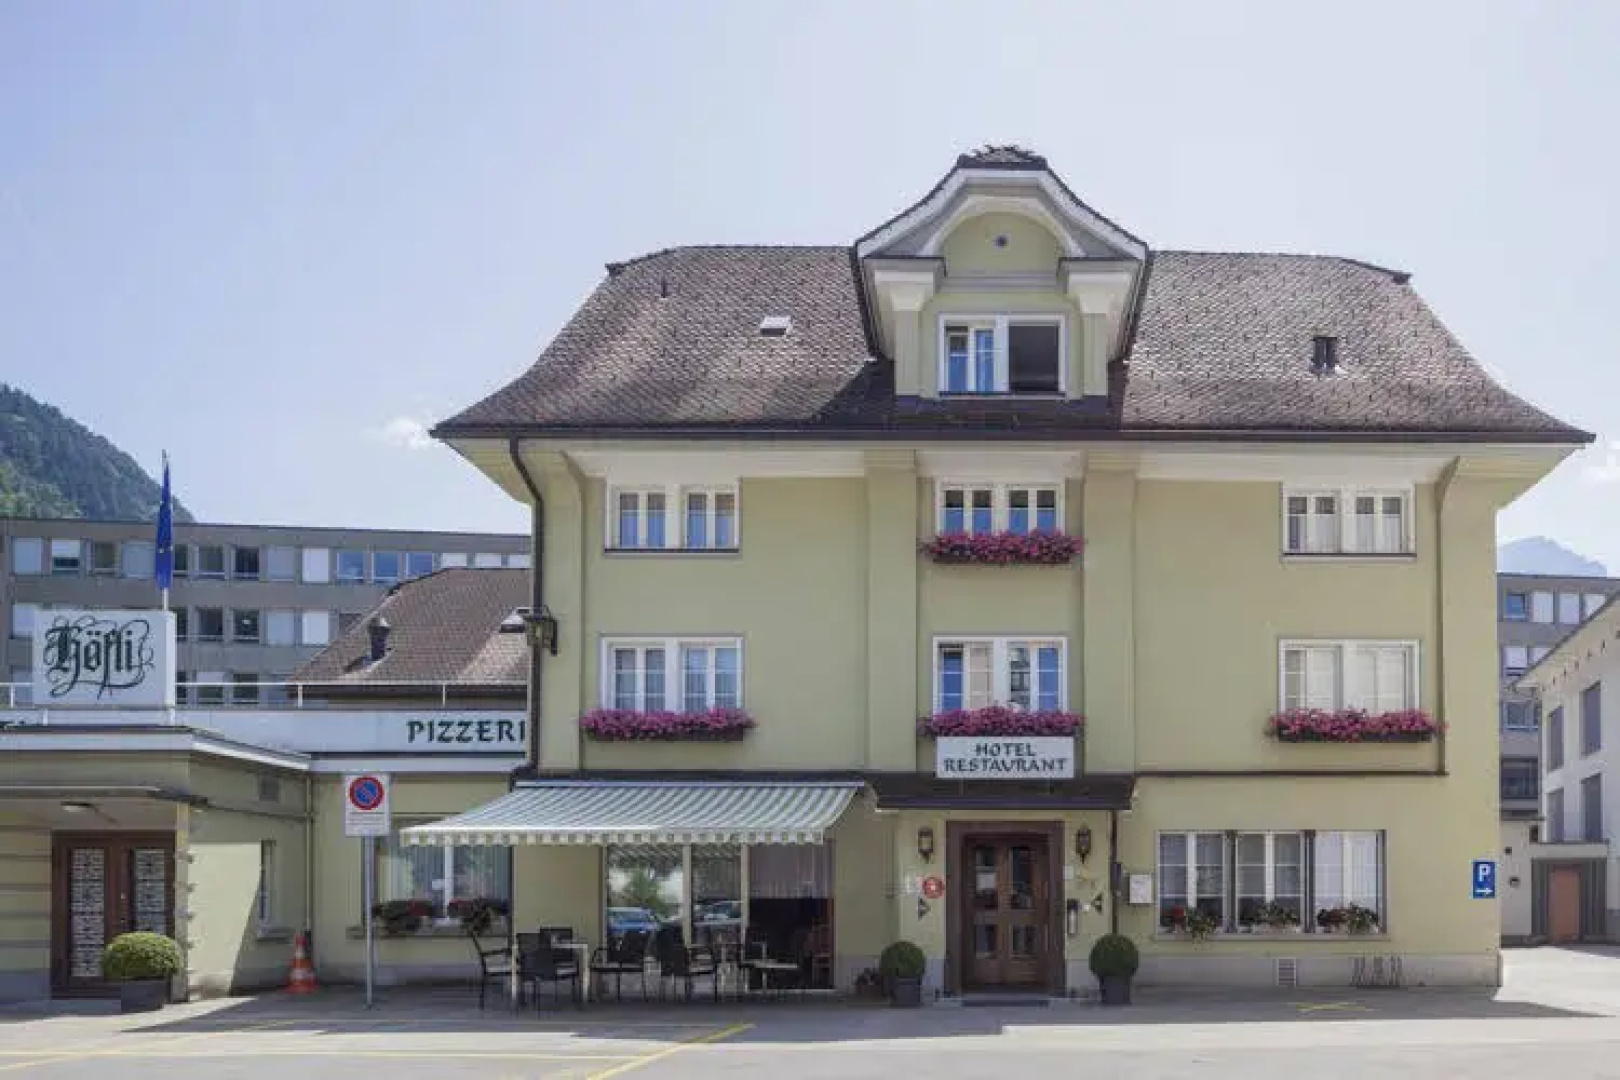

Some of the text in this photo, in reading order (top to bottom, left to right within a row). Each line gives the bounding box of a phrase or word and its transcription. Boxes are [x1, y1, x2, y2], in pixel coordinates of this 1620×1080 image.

[43, 616, 154, 699] Höfli
[974, 742, 1036, 757] HOTEL
[943, 757, 1067, 772] RESTAURANT
[1478, 863, 1491, 882] P
